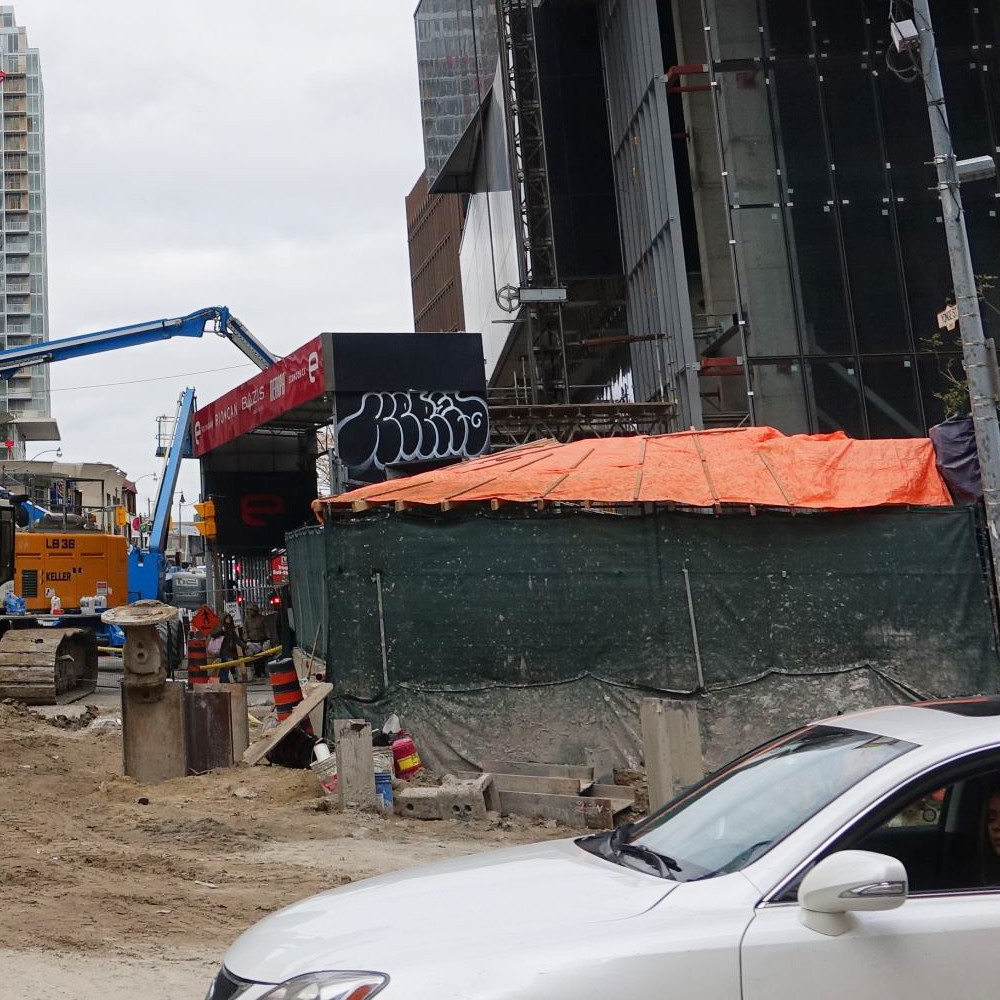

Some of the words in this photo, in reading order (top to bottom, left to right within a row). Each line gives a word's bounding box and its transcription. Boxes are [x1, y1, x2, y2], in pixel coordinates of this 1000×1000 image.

[46, 538, 60, 549] LB
[61, 538, 76, 549] 36
[46, 571, 72, 582] KELLER
